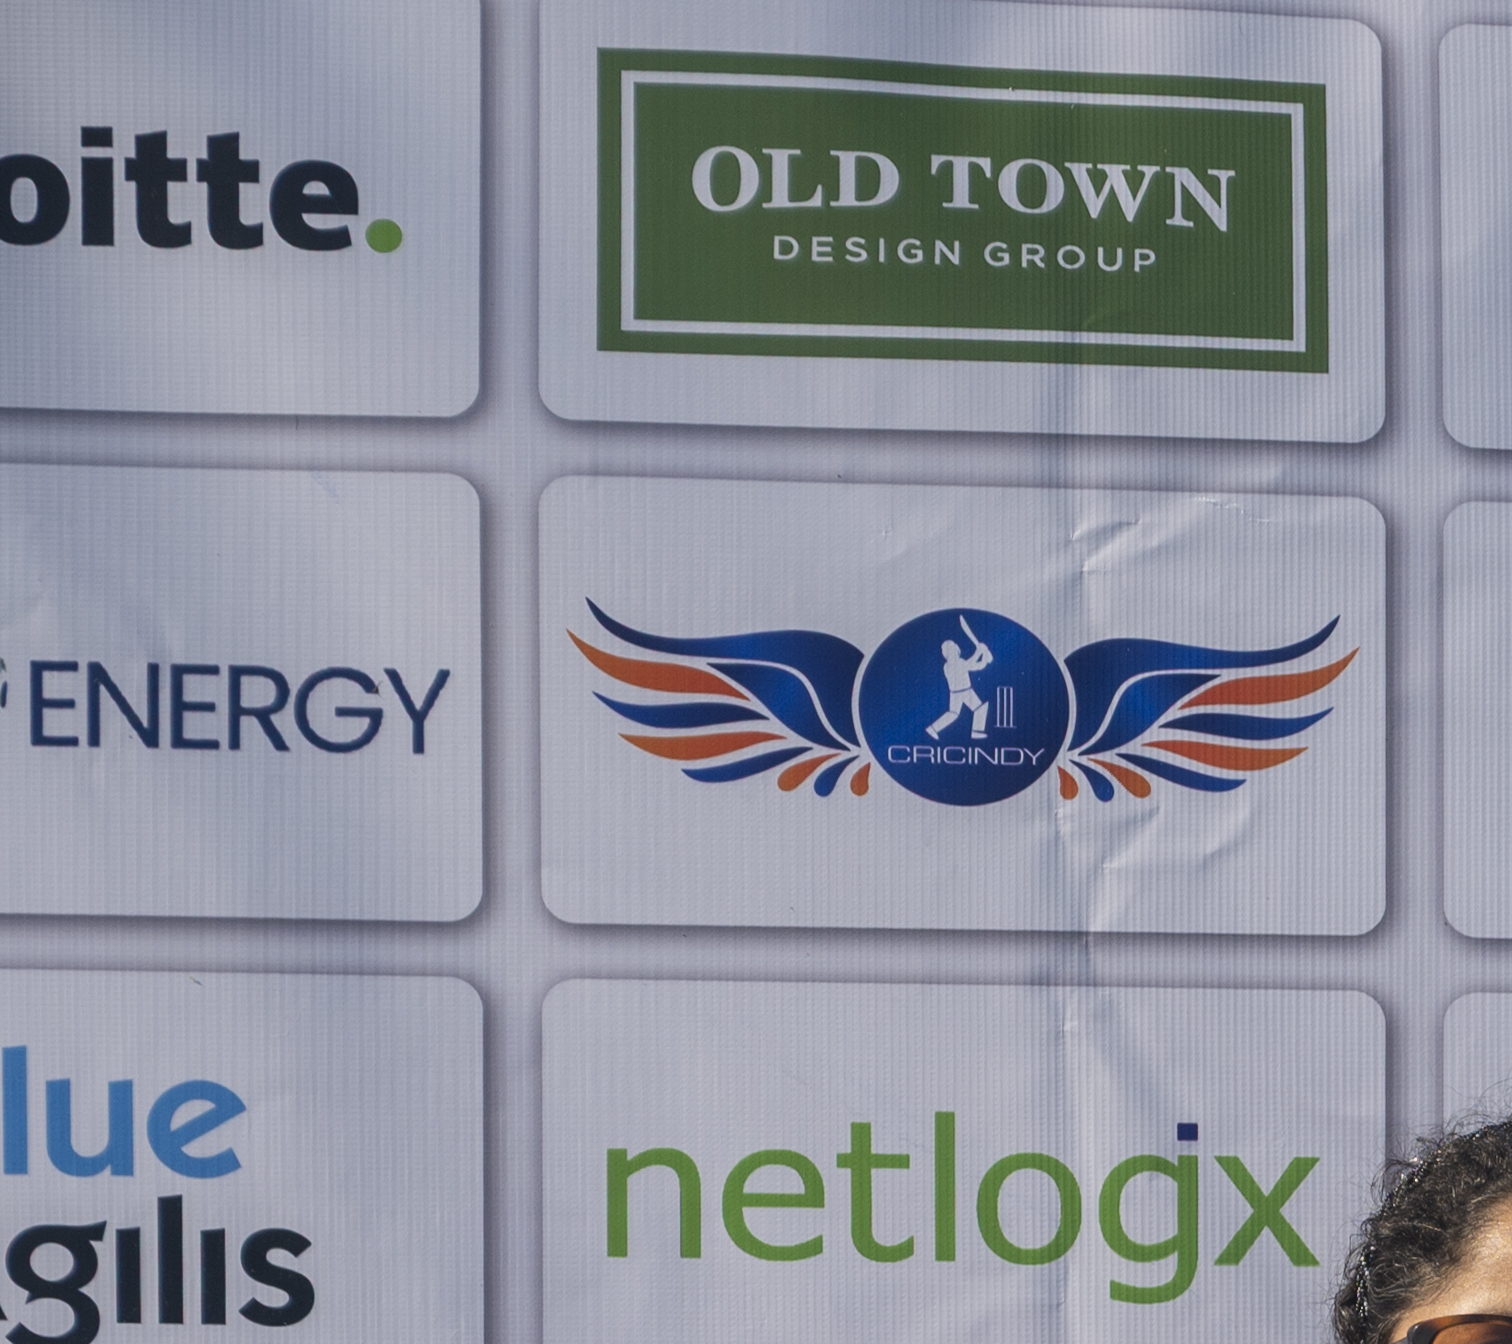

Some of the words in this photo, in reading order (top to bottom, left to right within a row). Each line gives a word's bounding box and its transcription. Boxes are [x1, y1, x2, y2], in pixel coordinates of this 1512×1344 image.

[690, 145, 900, 213] OLD
[930, 154, 1236, 232] TOWN
[772, 234, 962, 267] DESIGN
[983, 241, 1158, 273] GROUP
[29, 660, 451, 756] ENERGY
[886, 744, 1046, 768] CRICINDY
